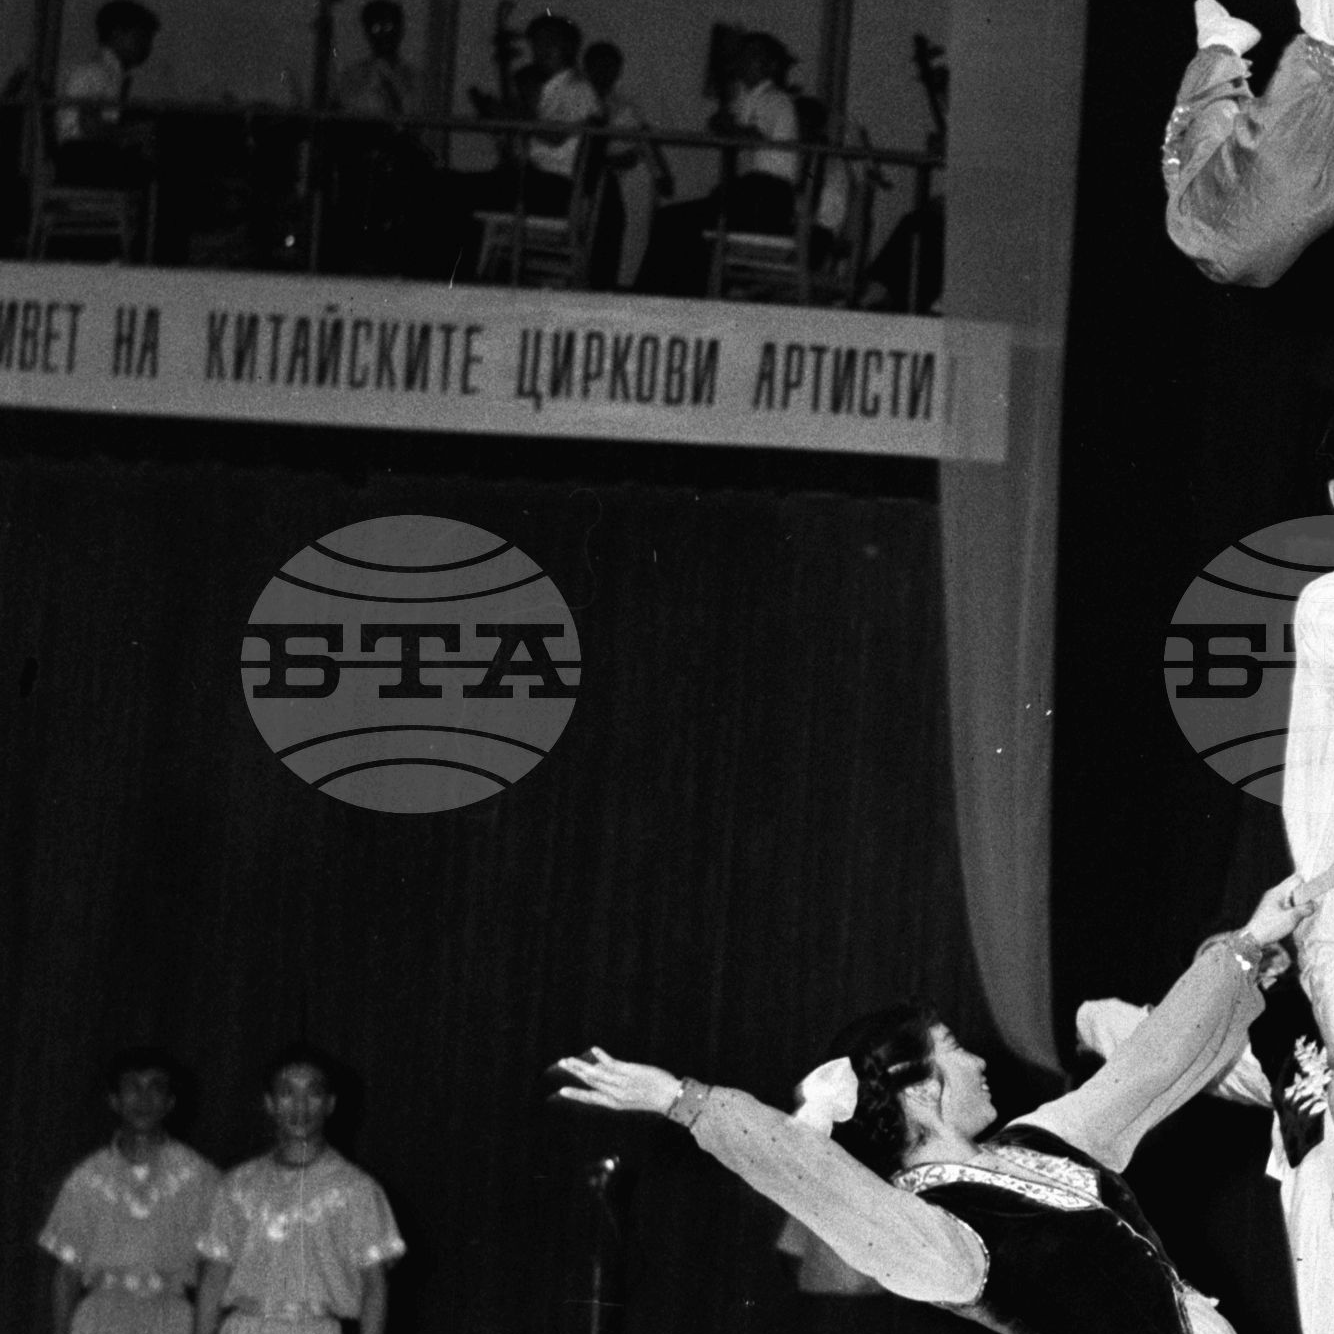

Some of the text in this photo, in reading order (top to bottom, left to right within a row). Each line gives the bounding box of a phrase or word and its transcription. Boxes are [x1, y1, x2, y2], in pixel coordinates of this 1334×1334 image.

[112, 304, 161, 378] НА
[204, 303, 486, 396] КИТАЙСКИТЕ
[515, 327, 720, 413] ЦИРКОВИ
